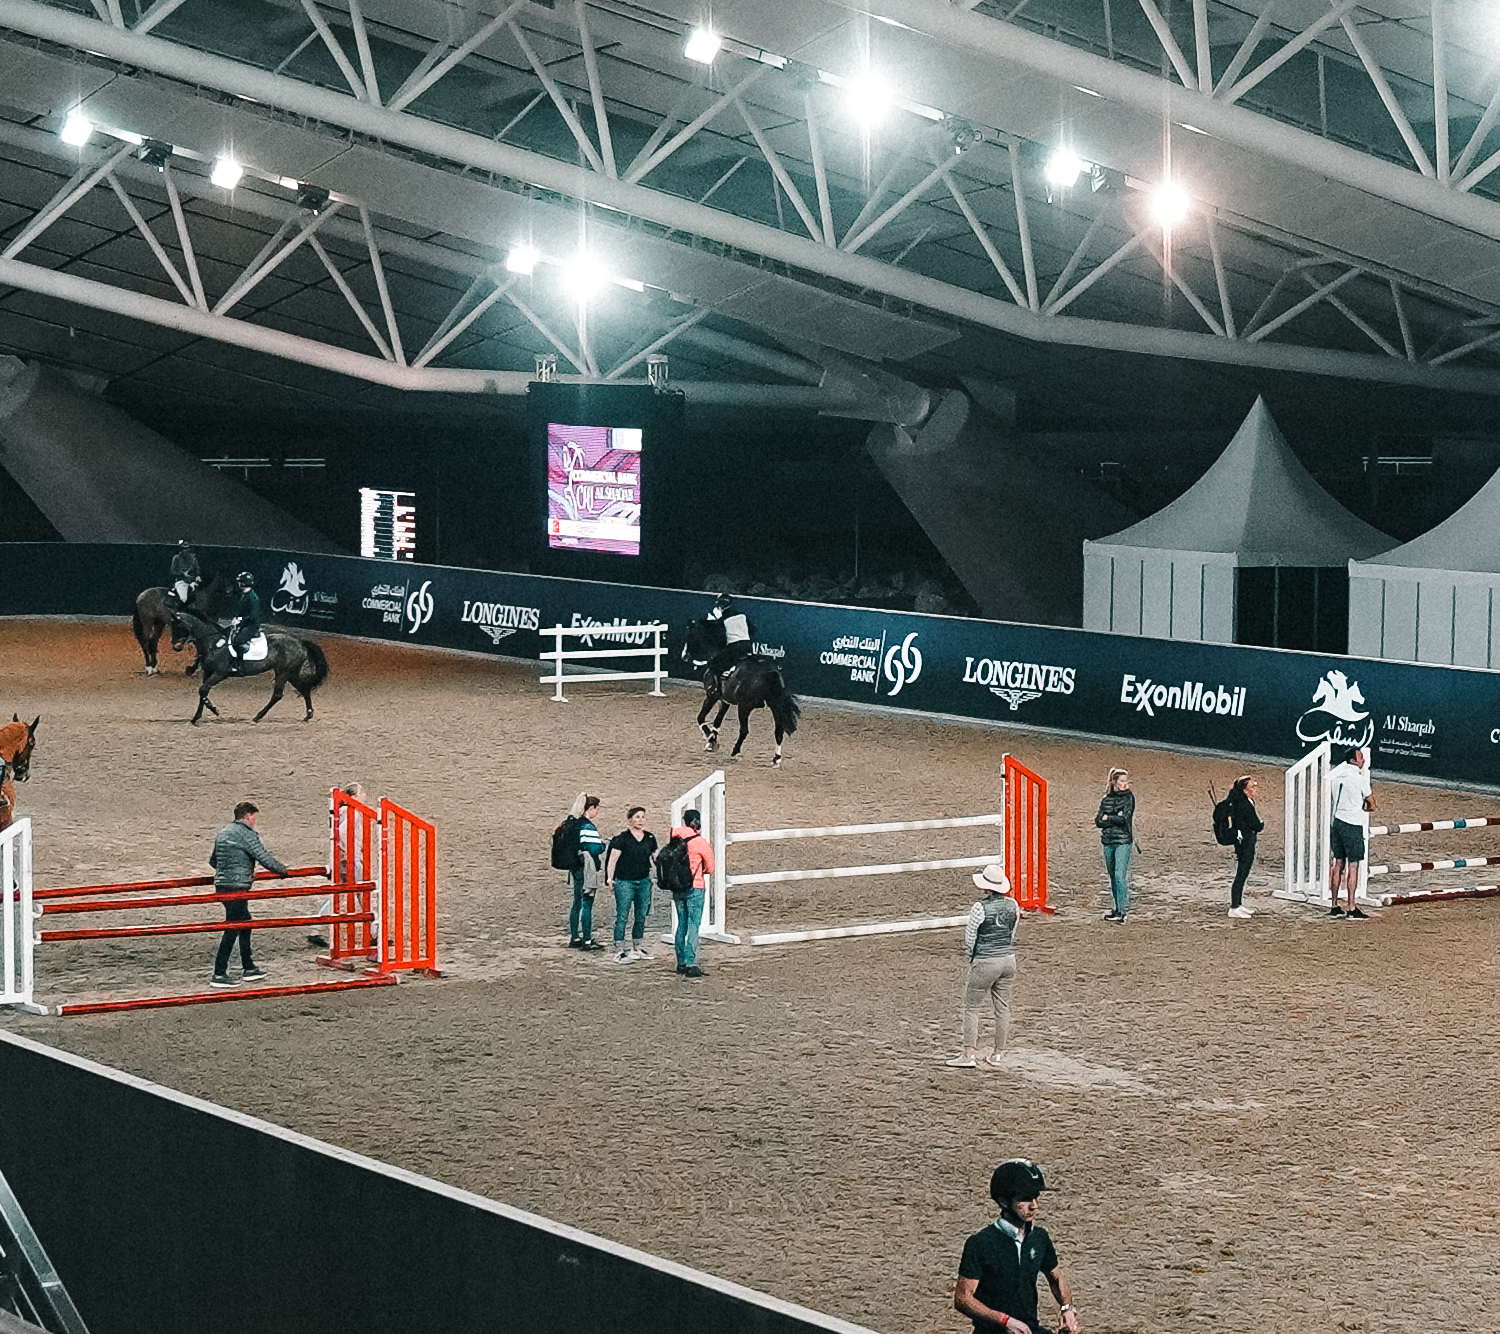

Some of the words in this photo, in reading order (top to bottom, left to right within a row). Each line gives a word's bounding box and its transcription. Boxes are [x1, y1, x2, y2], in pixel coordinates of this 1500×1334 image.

[461, 600, 540, 631] LONGINES
[820, 651, 877, 670] COMMERCIAL
[850, 668, 876, 683] BANK
[962, 657, 1076, 695] LONGINES
[1120, 674, 1246, 717] ExxonMobil
[1382, 714, 1396, 730] Al
[1397, 716, 1435, 737] Shaqab
